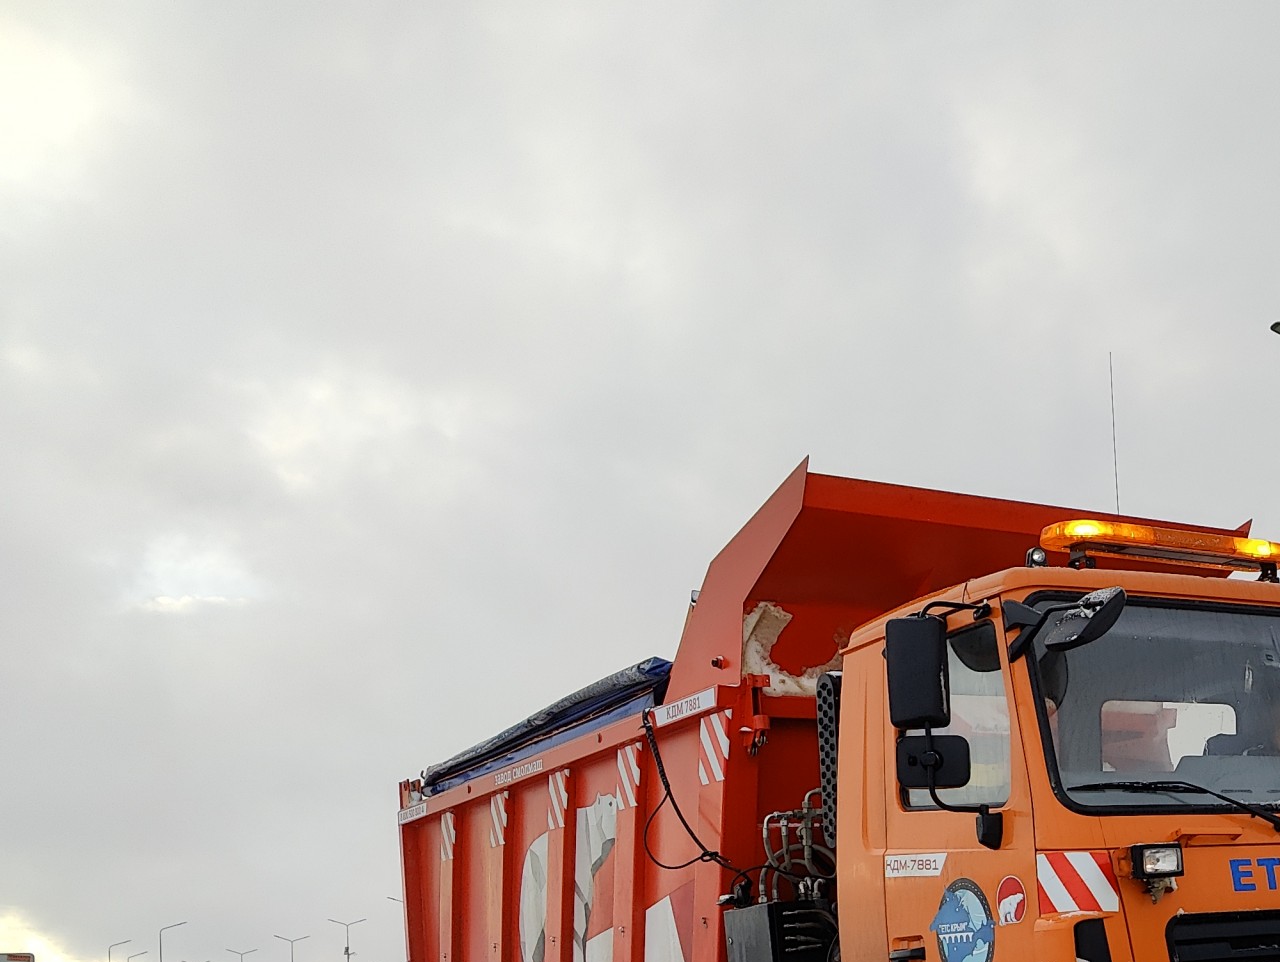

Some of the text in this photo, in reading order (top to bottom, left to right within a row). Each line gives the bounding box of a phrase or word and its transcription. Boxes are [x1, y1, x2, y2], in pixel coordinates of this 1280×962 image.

[666, 696, 701, 720] КДМ 7881
[886, 859, 939, 874] КДМ-7881
